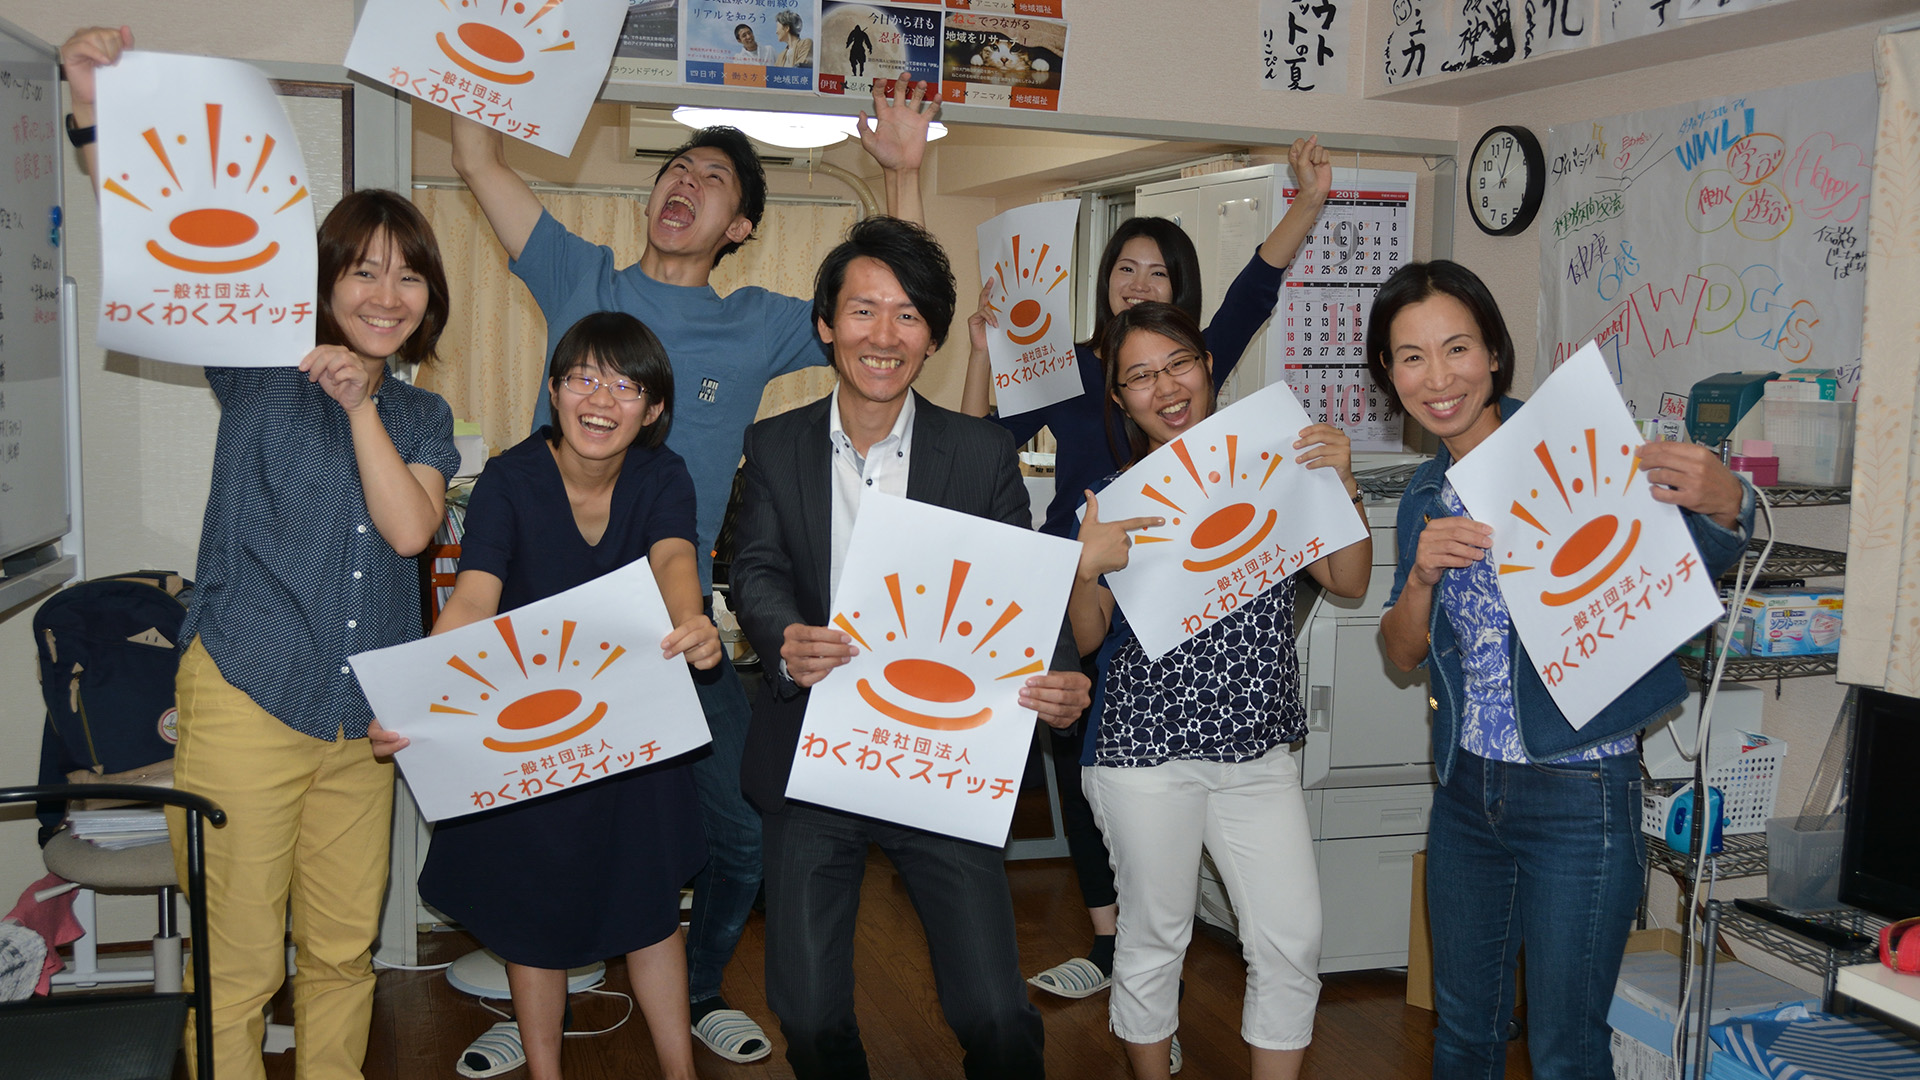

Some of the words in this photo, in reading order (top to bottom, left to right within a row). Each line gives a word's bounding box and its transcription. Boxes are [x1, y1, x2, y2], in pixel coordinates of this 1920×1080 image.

[693, 8, 767, 24] リアルを知ろう
[1020, 4, 1052, 14] 地域福祉
[868, 12, 934, 30] 今日から君も
[953, 13, 1030, 30] ねこでつながる
[879, 32, 935, 48] 忍者伝道師
[1264, 29, 1277, 79] りこぴん
[613, 66, 673, 77] ラウンドデザイン
[690, 69, 717, 79] 四日市
[731, 72, 758, 82] 働き方
[773, 75, 809, 86] 地域医療
[428, 68, 514, 111] 一般社団法人
[820, 80, 837, 90] 伊賀
[850, 82, 866, 92] 忍者
[388, 66, 541, 140] わくわくスイッチ
[952, 89, 960, 98] 津
[972, 91, 1005, 100] アニマル
[1015, 95, 1048, 105] 地域福祉
[1491, 144, 1500, 156] 11
[1502, 137, 1512, 149] 12
[1483, 160, 1493, 172] 10
[1731, 139, 1781, 182] 学ぶ
[1480, 177, 1485, 189] 9
[1796, 149, 1859, 211] Happy
[1336, 191, 1359, 199] 2018
[1482, 196, 1488, 208] 8
[1698, 186, 1733, 215] 働く
[1393, 208, 1396, 216] 1
[1490, 209, 1496, 221] 7
[1739, 189, 1791, 225] 遊ぶ
[1325, 221, 1330, 229] 4
[1342, 222, 1347, 230] 5
[1358, 222, 1364, 230] 6
[1376, 222, 1380, 230] 7
[1392, 223, 1397, 231] 8
[1501, 213, 1507, 225] 6
[1306, 236, 1313, 244] 10
[1323, 236, 1329, 244] 11
[1340, 236, 1347, 245] 12
[1357, 237, 1364, 245] 13
[1373, 237, 1380, 245] 14
[1390, 237, 1398, 246] 15
[1306, 250, 1313, 259] 17
[1323, 251, 1330, 259] 18
[1340, 251, 1347, 260] 19
[1356, 251, 1364, 260] 20
[1373, 252, 1380, 260] 21
[1389, 252, 1398, 261] 22
[1567, 231, 1609, 285] 健康
[1304, 265, 1313, 274] 24
[1321, 266, 1331, 274] 25
[1338, 266, 1348, 275] 26
[1355, 266, 1364, 275] 27
[1372, 267, 1381, 275] 28
[153, 283, 270, 299] 一般社団法人
[1357, 289, 1360, 297] 1
[104, 301, 313, 326] わくわくスイッチ
[1289, 303, 1294, 311] 4
[1306, 303, 1310, 311] 5
[1323, 303, 1328, 311] 6
[1340, 303, 1344, 311] 7
[1356, 304, 1361, 312] 8
[1288, 318, 1293, 326] 11
[1304, 318, 1312, 326] 12
[1322, 318, 1328, 326] 13
[1338, 318, 1345, 326] 14
[1355, 318, 1362, 326] 15
[1287, 333, 1294, 341] 18
[1304, 333, 1312, 341] 19
[1320, 333, 1329, 341] 20
[1338, 333, 1345, 341] 21
[1354, 333, 1362, 341] 22
[1015, 342, 1056, 363] 一般社団法人
[1286, 348, 1295, 356] 25
[1303, 348, 1312, 356] 26
[1320, 348, 1328, 356] 27
[1337, 348, 1345, 356] 28
[1354, 348, 1362, 356] 29
[995, 349, 1075, 389] わくわくスイッチ
[1305, 370, 1309, 378] 1
[1322, 370, 1326, 378] 2
[1338, 370, 1343, 378] 3
[1355, 370, 1359, 378] 4
[1304, 385, 1309, 393] 8
[1322, 385, 1326, 393] 9
[1354, 385, 1359, 393] 11
[1370, 385, 1377, 393] 12
[1303, 399, 1310, 407] 15
[1320, 399, 1327, 407] 16
[1353, 399, 1360, 407] 18
[1369, 399, 1376, 407] 19
[1385, 399, 1390, 407] 2
[1318, 414, 1327, 422] 23
[1352, 414, 1360, 422] 25
[1368, 414, 1377, 422] 26
[1384, 414, 1392, 422] 27
[1204, 544, 1286, 596] 一般社団法人
[1181, 537, 1325, 635] わくわくスイッチ
[1560, 565, 1652, 637] 一般社団法人
[1542, 552, 1697, 687] わくわくスイッチ
[852, 727, 971, 765] 一般社団法人
[503, 738, 613, 776] 一般社団法人
[801, 732, 1014, 800] わくわくスイッチ
[470, 740, 661, 809] わくわくスイッチ
